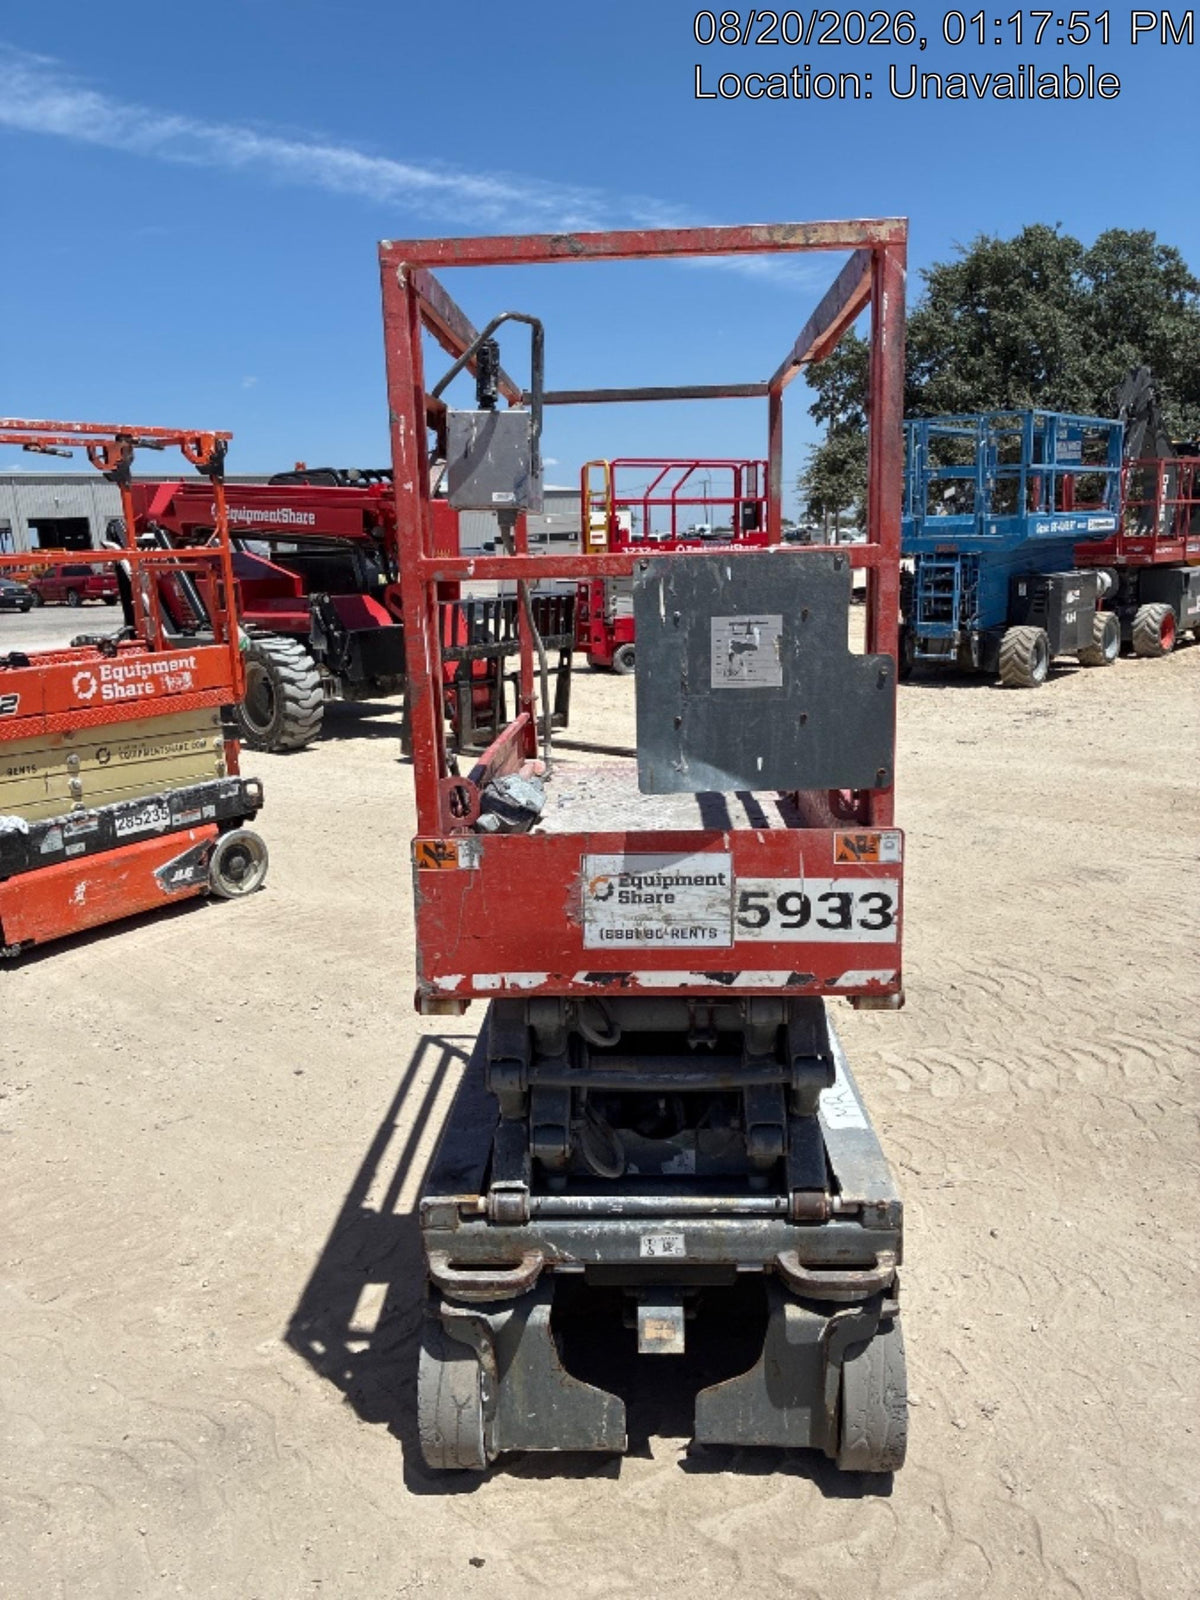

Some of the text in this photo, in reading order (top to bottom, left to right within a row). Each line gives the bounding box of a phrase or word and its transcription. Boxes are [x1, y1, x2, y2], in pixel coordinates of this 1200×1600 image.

[100, 656, 196, 682] Equipment
[102, 681, 155, 700] Share
[171, 867, 194, 882] JLG
[618, 872, 726, 890] Equipment
[618, 890, 675, 904] Share
[738, 891, 893, 931] 5933
